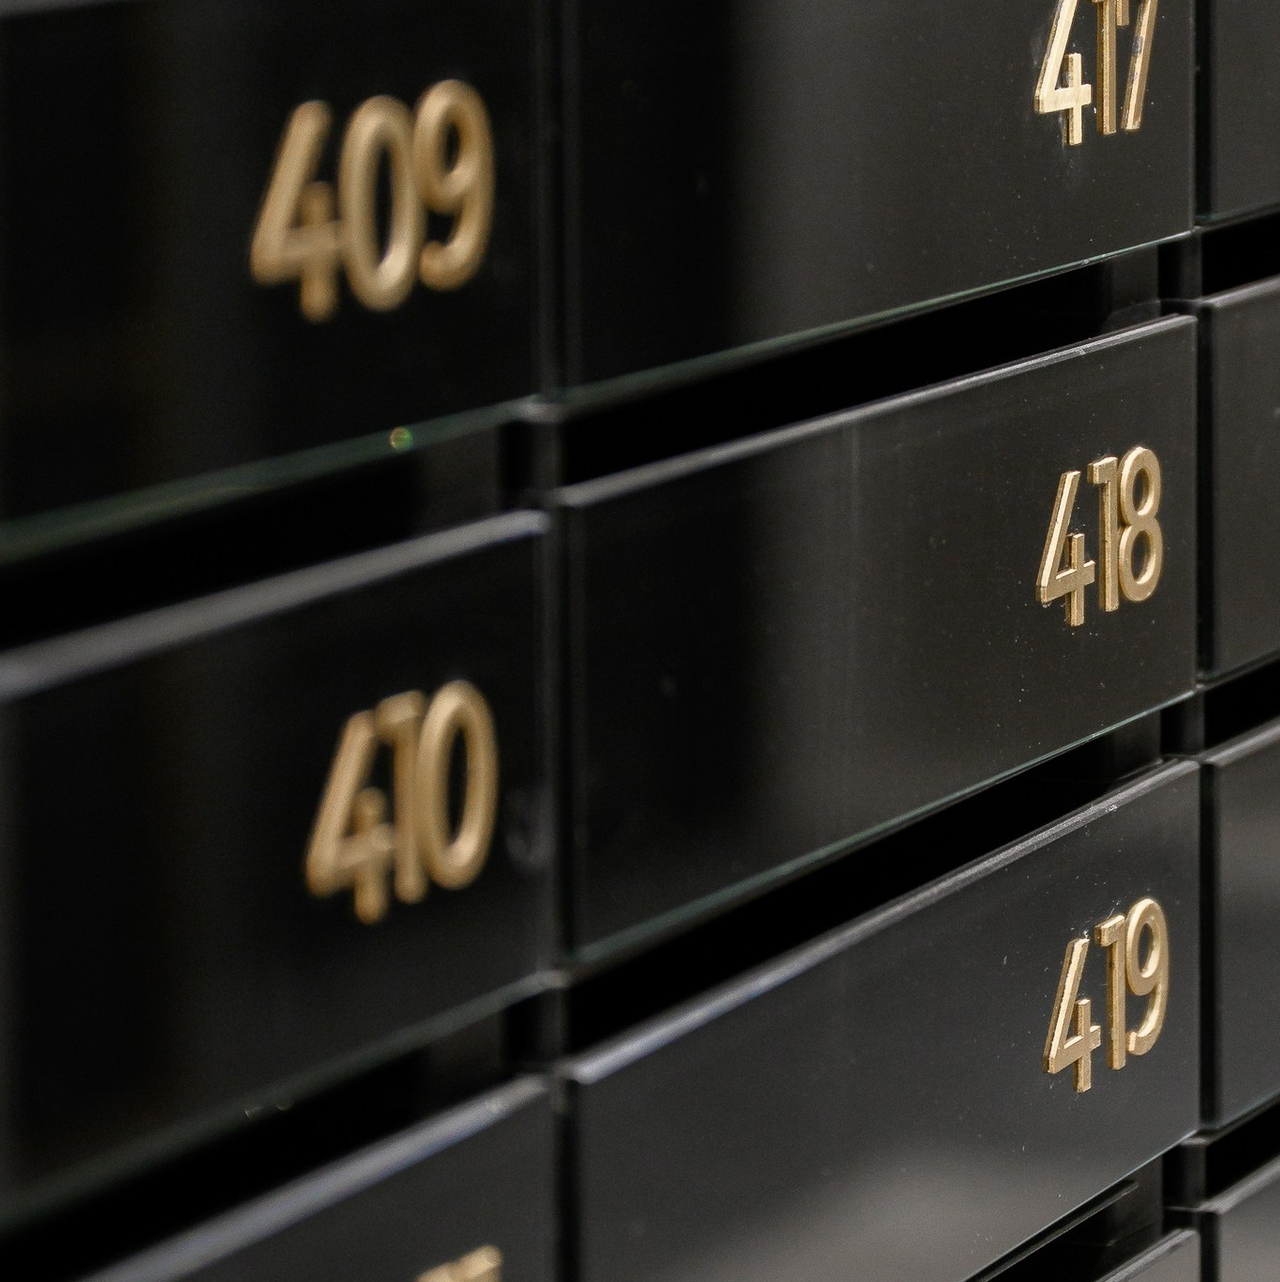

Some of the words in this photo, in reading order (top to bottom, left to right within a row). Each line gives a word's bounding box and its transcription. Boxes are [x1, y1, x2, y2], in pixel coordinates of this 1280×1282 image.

[251, 79, 493, 319] 409
[1037, 448, 1163, 626] 418
[305, 681, 498, 922] 410
[1044, 899, 1169, 1093] 419
